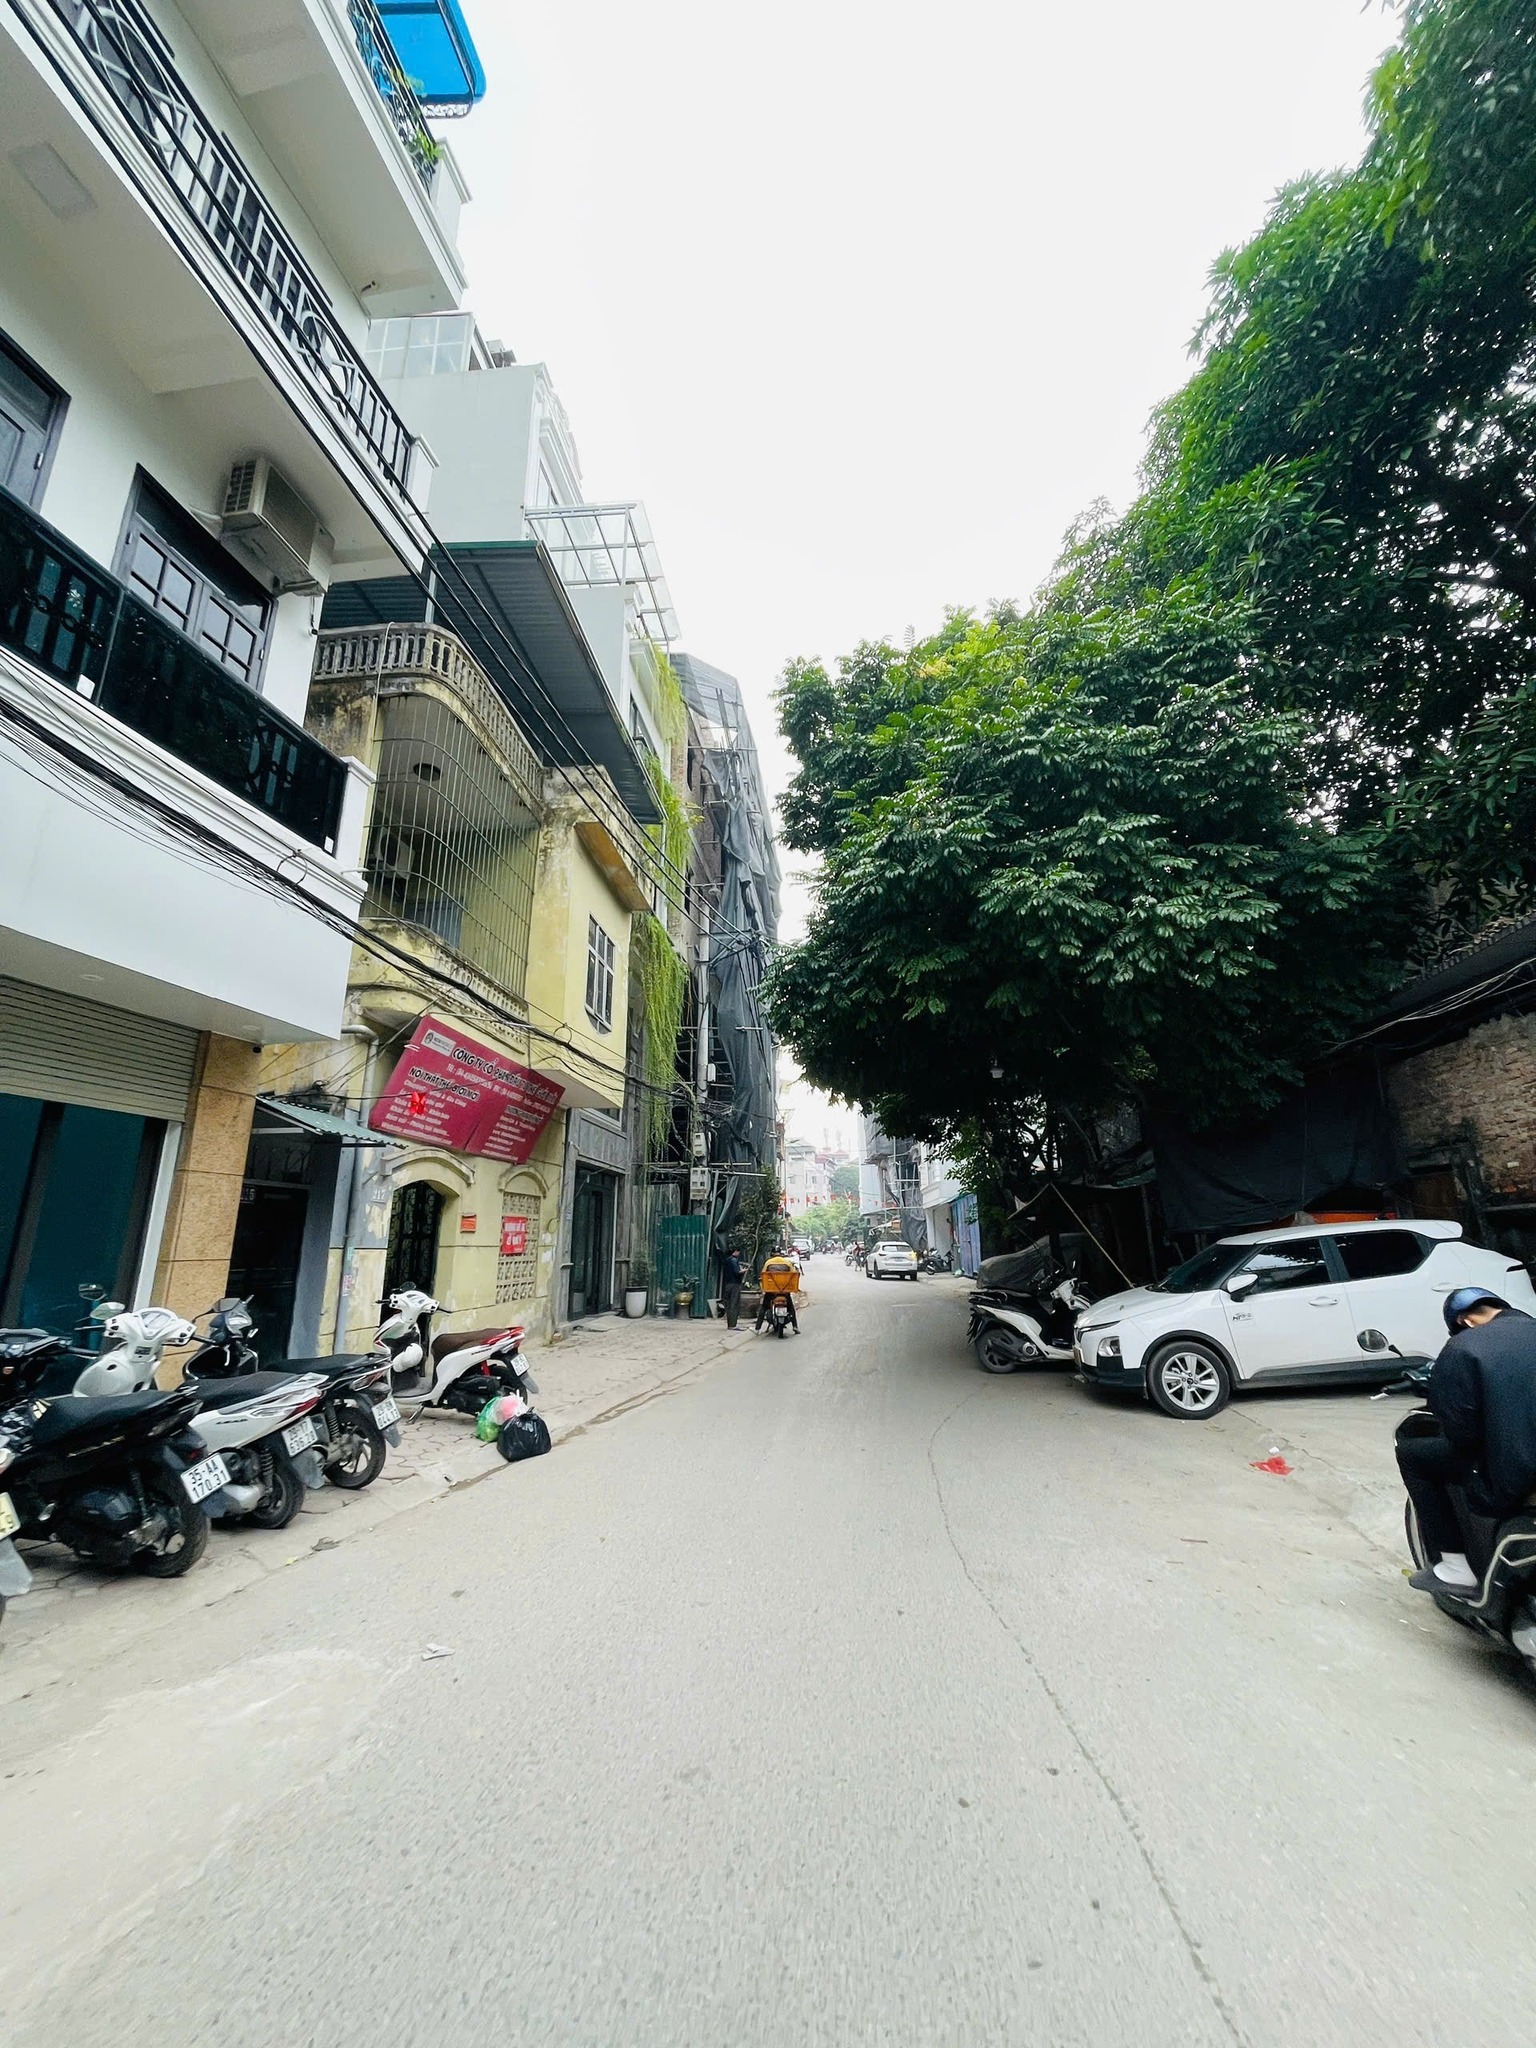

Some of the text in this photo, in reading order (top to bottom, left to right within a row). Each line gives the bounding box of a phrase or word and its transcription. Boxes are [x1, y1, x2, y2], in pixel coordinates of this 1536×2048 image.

[452, 1047, 474, 1067] CÔNG
[474, 1057, 485, 1070] TY
[188, 1459, 218, 1485] 35-AA
[192, 1469, 228, 1498] 170.31
